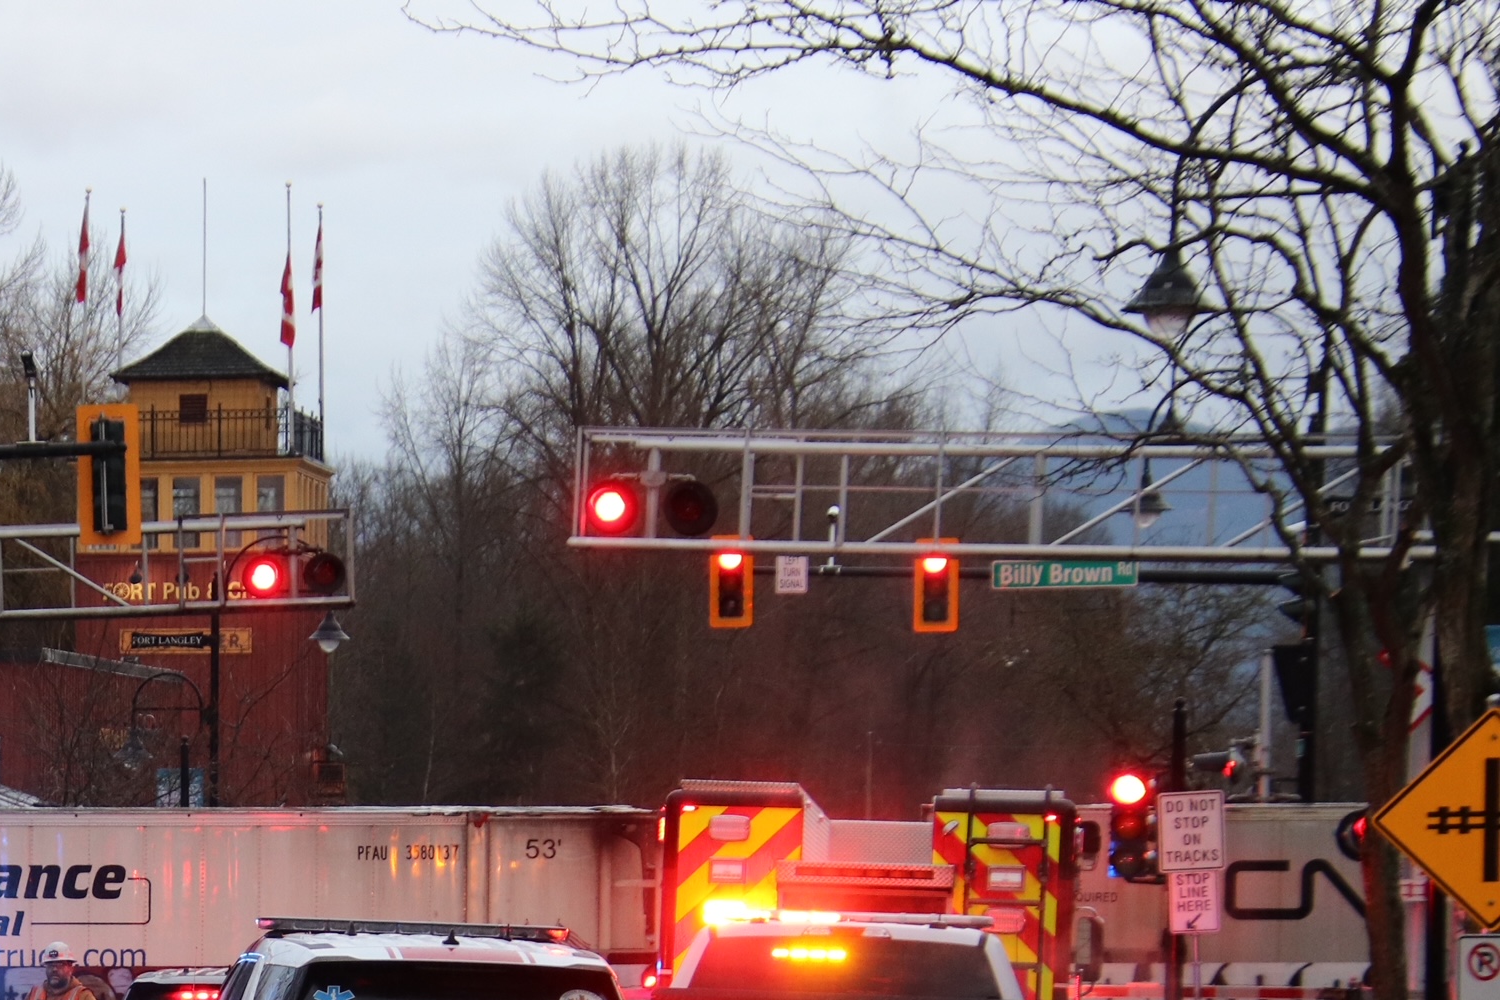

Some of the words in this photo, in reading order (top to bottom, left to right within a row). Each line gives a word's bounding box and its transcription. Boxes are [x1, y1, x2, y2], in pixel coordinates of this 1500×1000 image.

[783, 567, 801, 577] TURN
[1000, 563, 1043, 586] Billy
[1049, 562, 1112, 584] Brown
[1117, 561, 1133, 576] Rd
[780, 578, 804, 589] SIGNAL
[162, 582, 200, 600] Pub
[133, 635, 157, 645] FORT
[158, 635, 203, 645] LANGLEY
[1165, 801, 1184, 813] DO
[1189, 799, 1217, 812] NOT
[1174, 815, 1209, 829] STOP
[1183, 833, 1201, 846] ON
[357, 845, 388, 860] PFAU
[525, 838, 562, 859] 53'
[1165, 849, 1219, 863] TRACKS
[1176, 872, 1211, 886] STOP
[1075, 891, 1119, 903] QUIRED
[1179, 887, 1208, 898] LINE
[1177, 899, 1211, 911] HERE
